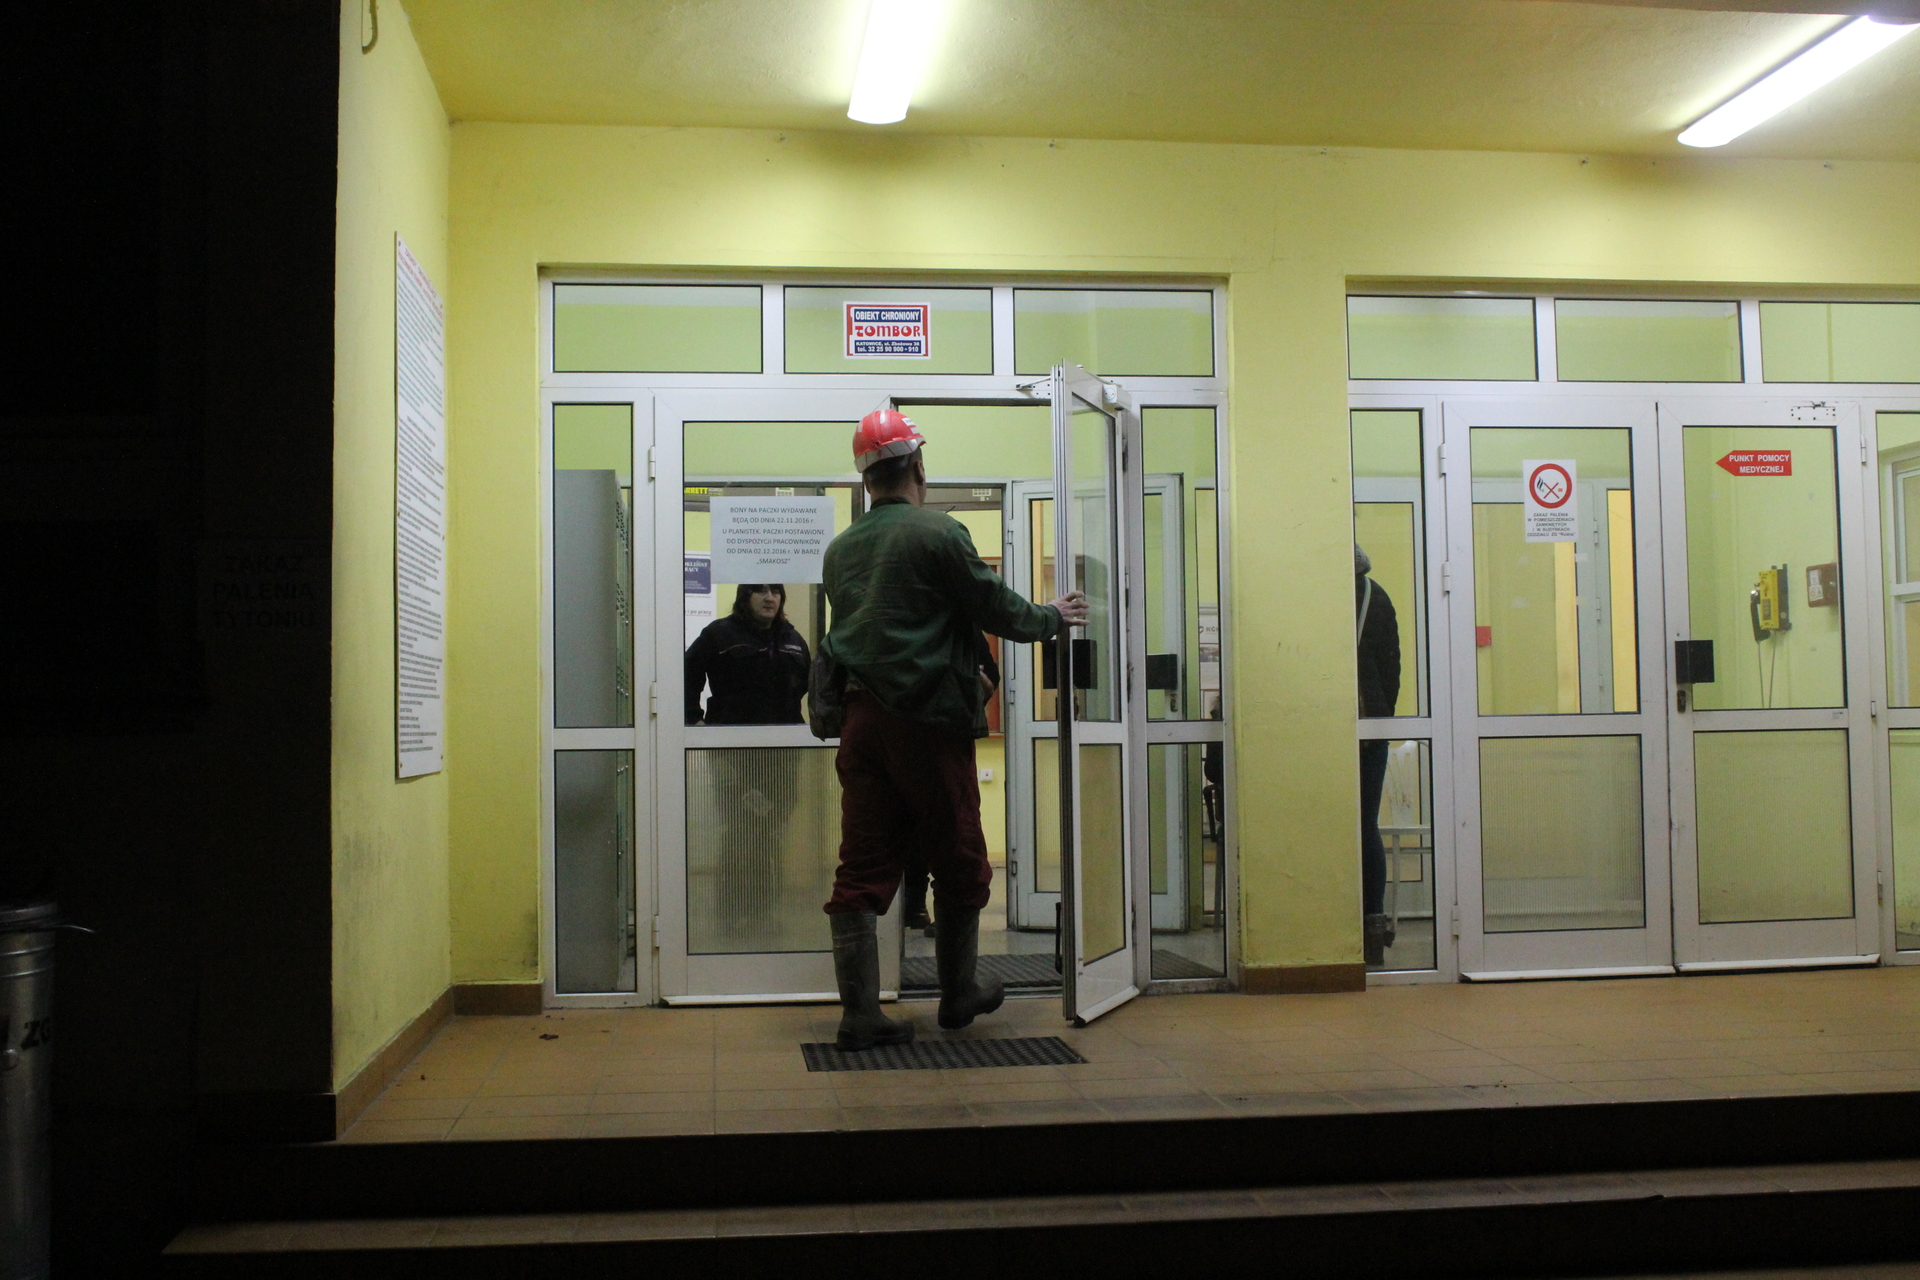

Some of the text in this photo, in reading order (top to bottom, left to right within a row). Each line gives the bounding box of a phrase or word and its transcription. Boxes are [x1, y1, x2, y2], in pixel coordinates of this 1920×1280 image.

[855, 310, 920, 321] OBIEKT CHRONIONY
[1729, 454, 1790, 462] PUNKT POMOCY
[1739, 465, 1784, 473] MEDYCZNEJ
[212, 582, 315, 601] PALENIA
[212, 610, 315, 629] TYTONIU
